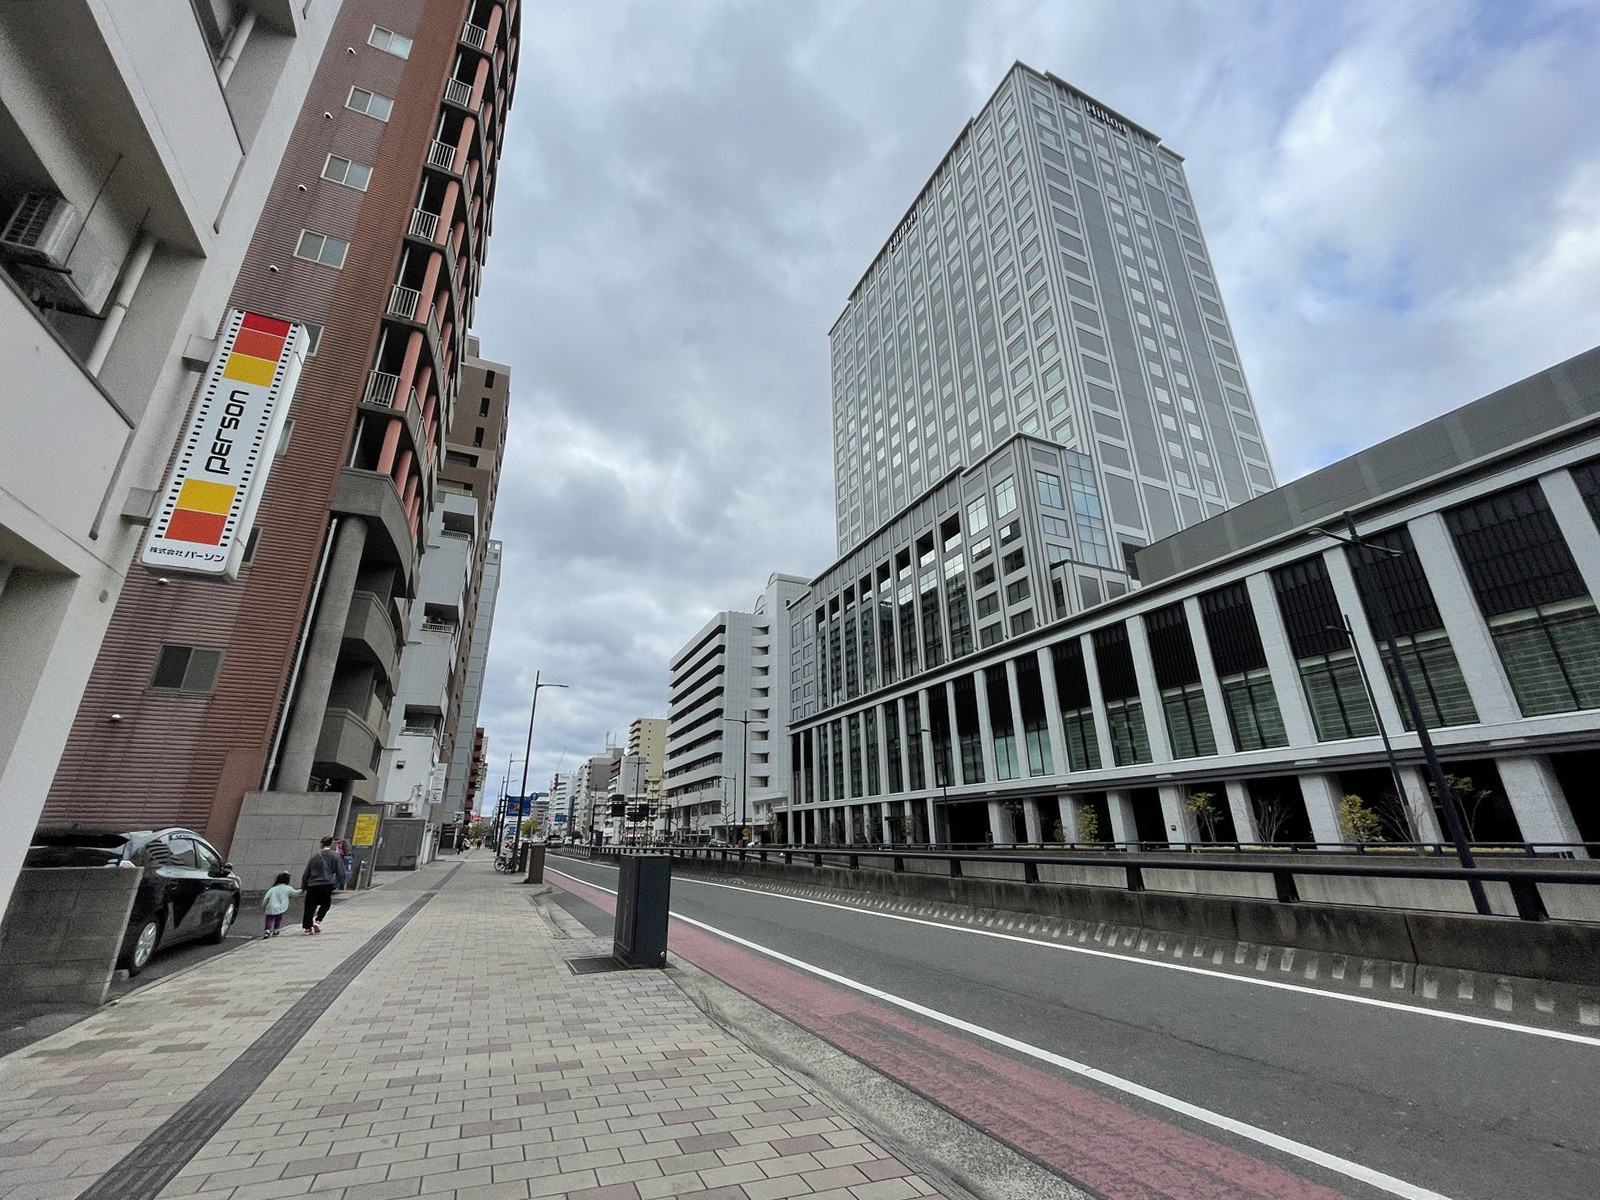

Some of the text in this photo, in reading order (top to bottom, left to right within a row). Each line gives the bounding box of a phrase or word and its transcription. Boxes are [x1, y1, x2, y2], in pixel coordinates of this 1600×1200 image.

[1085, 100, 1127, 133] Hilton
[889, 210, 917, 252] Hilton
[204, 389, 250, 475] person
